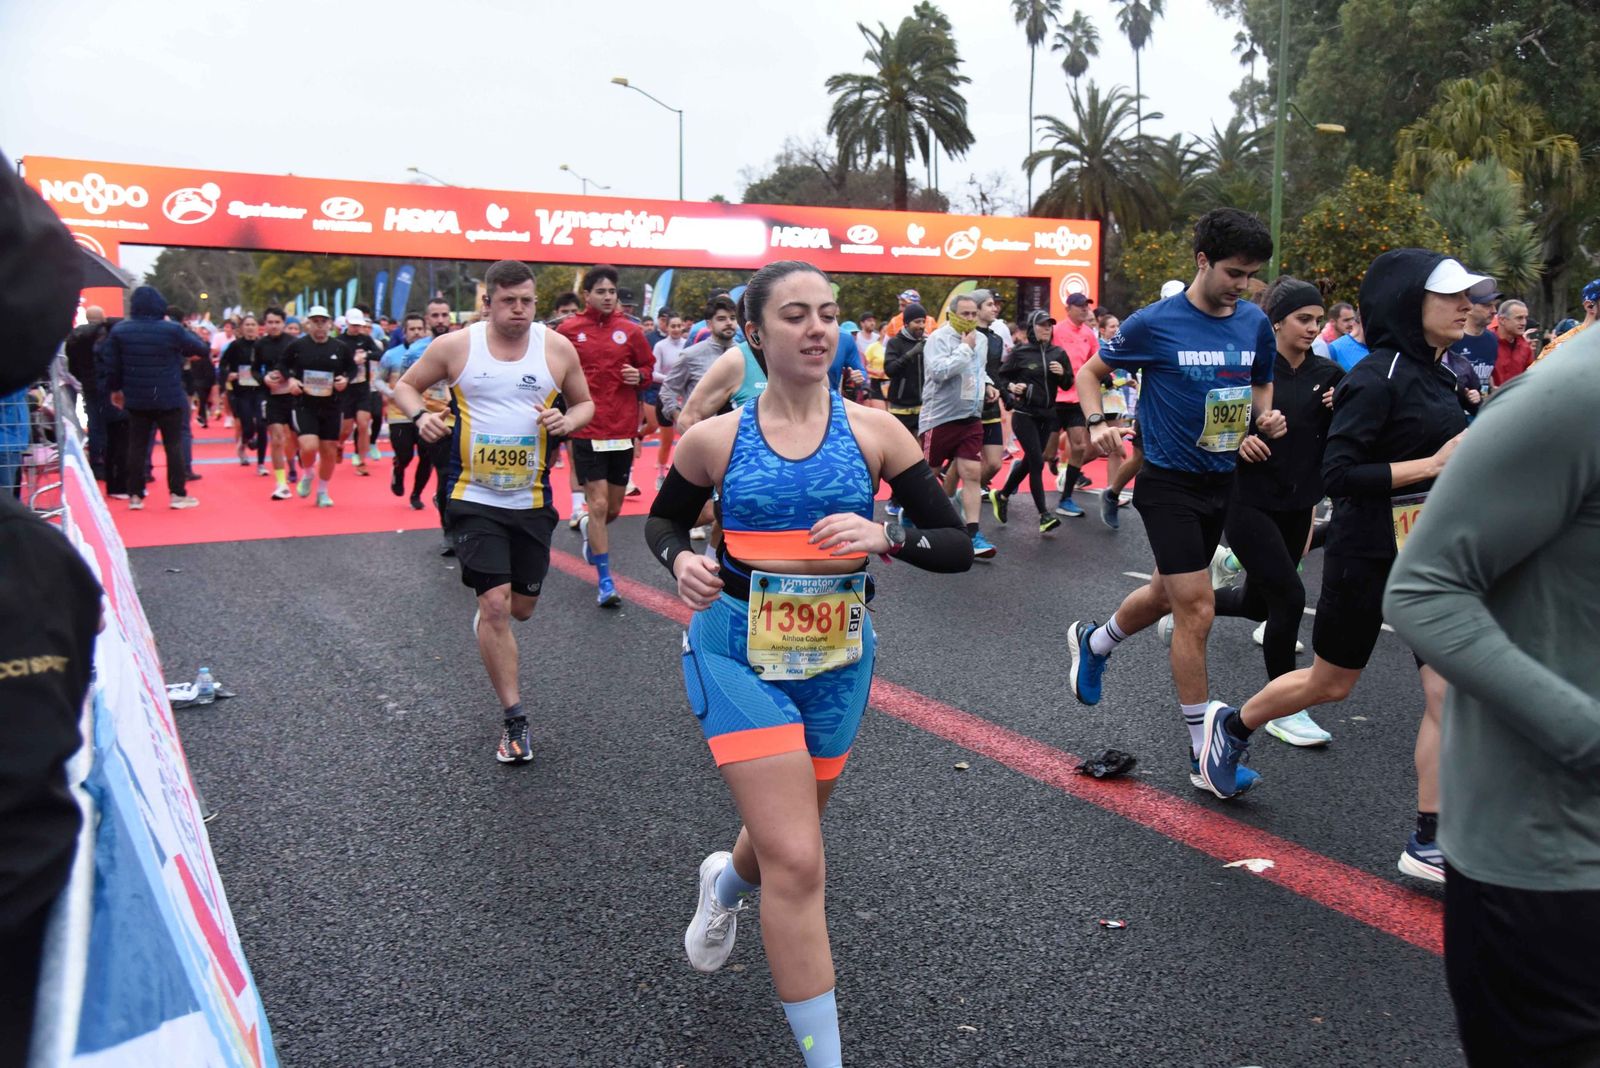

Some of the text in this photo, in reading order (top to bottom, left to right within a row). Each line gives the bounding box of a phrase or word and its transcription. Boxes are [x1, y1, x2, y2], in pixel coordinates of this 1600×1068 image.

[383, 207, 462, 234] HOKA
[770, 225, 832, 249] HOKA
[1212, 403, 1245, 425] 9927
[478, 447, 527, 466] 14398
[794, 578, 834, 587] maratón
[761, 600, 846, 634] 13981
